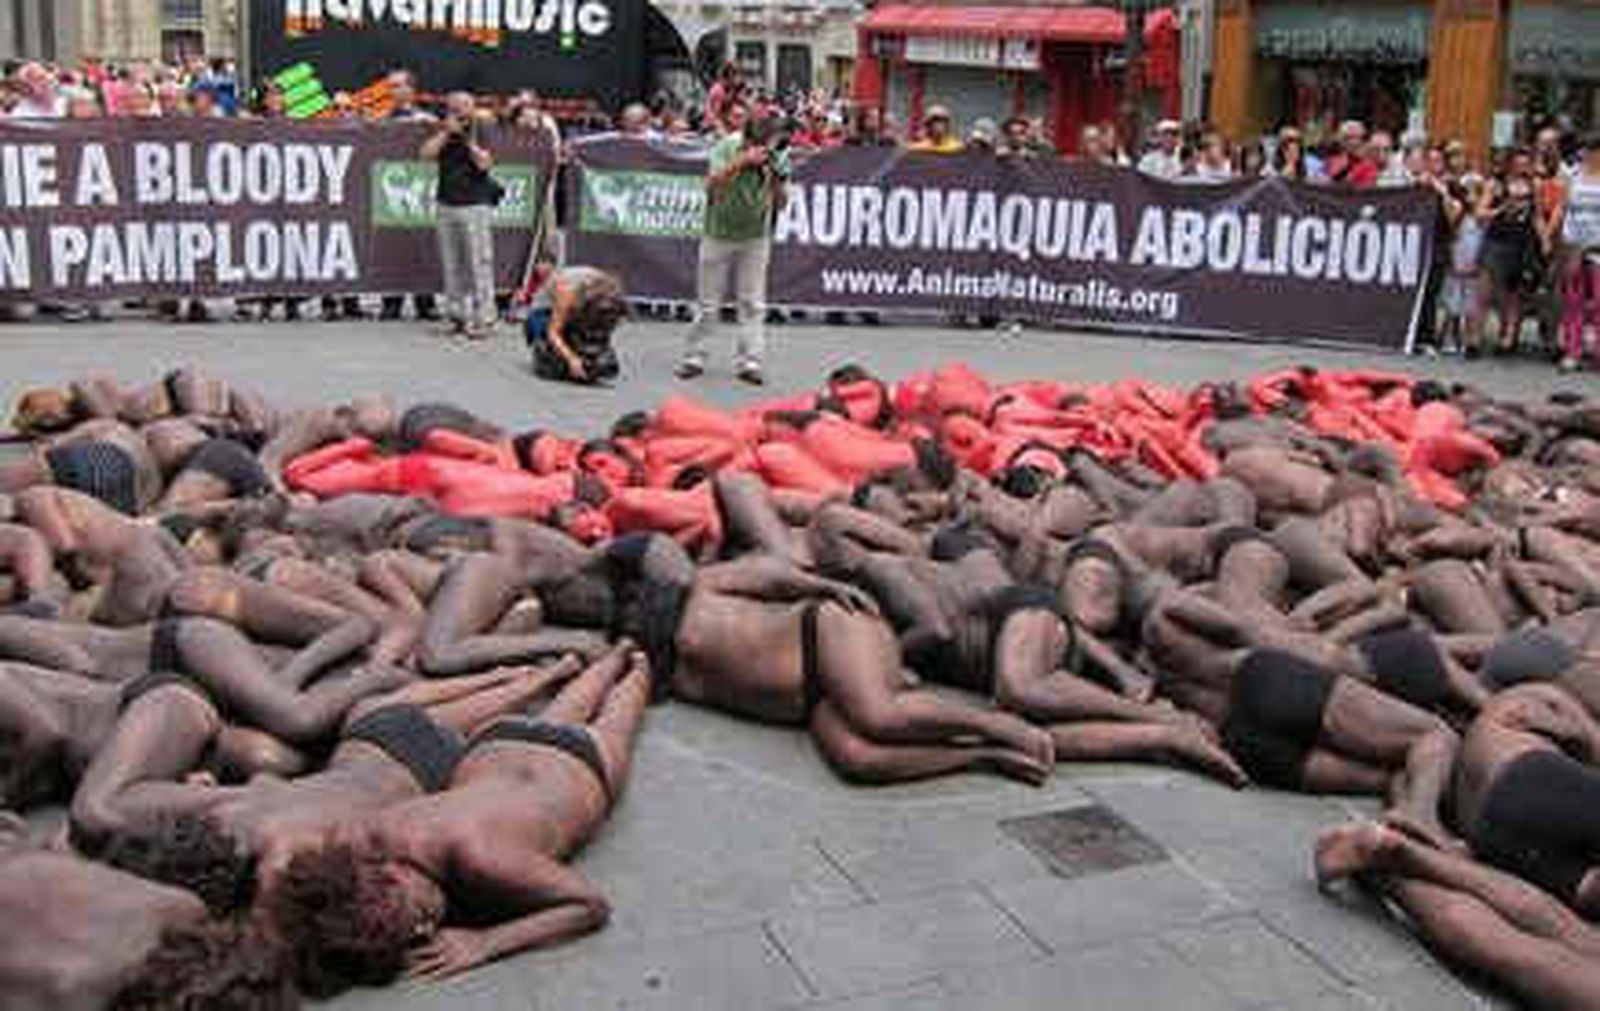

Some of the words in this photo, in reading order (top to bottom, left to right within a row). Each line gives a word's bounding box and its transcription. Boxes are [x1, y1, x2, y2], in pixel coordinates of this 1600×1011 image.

[75, 144, 119, 206] A
[134, 142, 354, 205] BLOODY
[50, 220, 358, 287] PAMPLONA
[775, 183, 1120, 262] AUROMAQUIA
[1129, 204, 1422, 286] ABOLICIÓN
